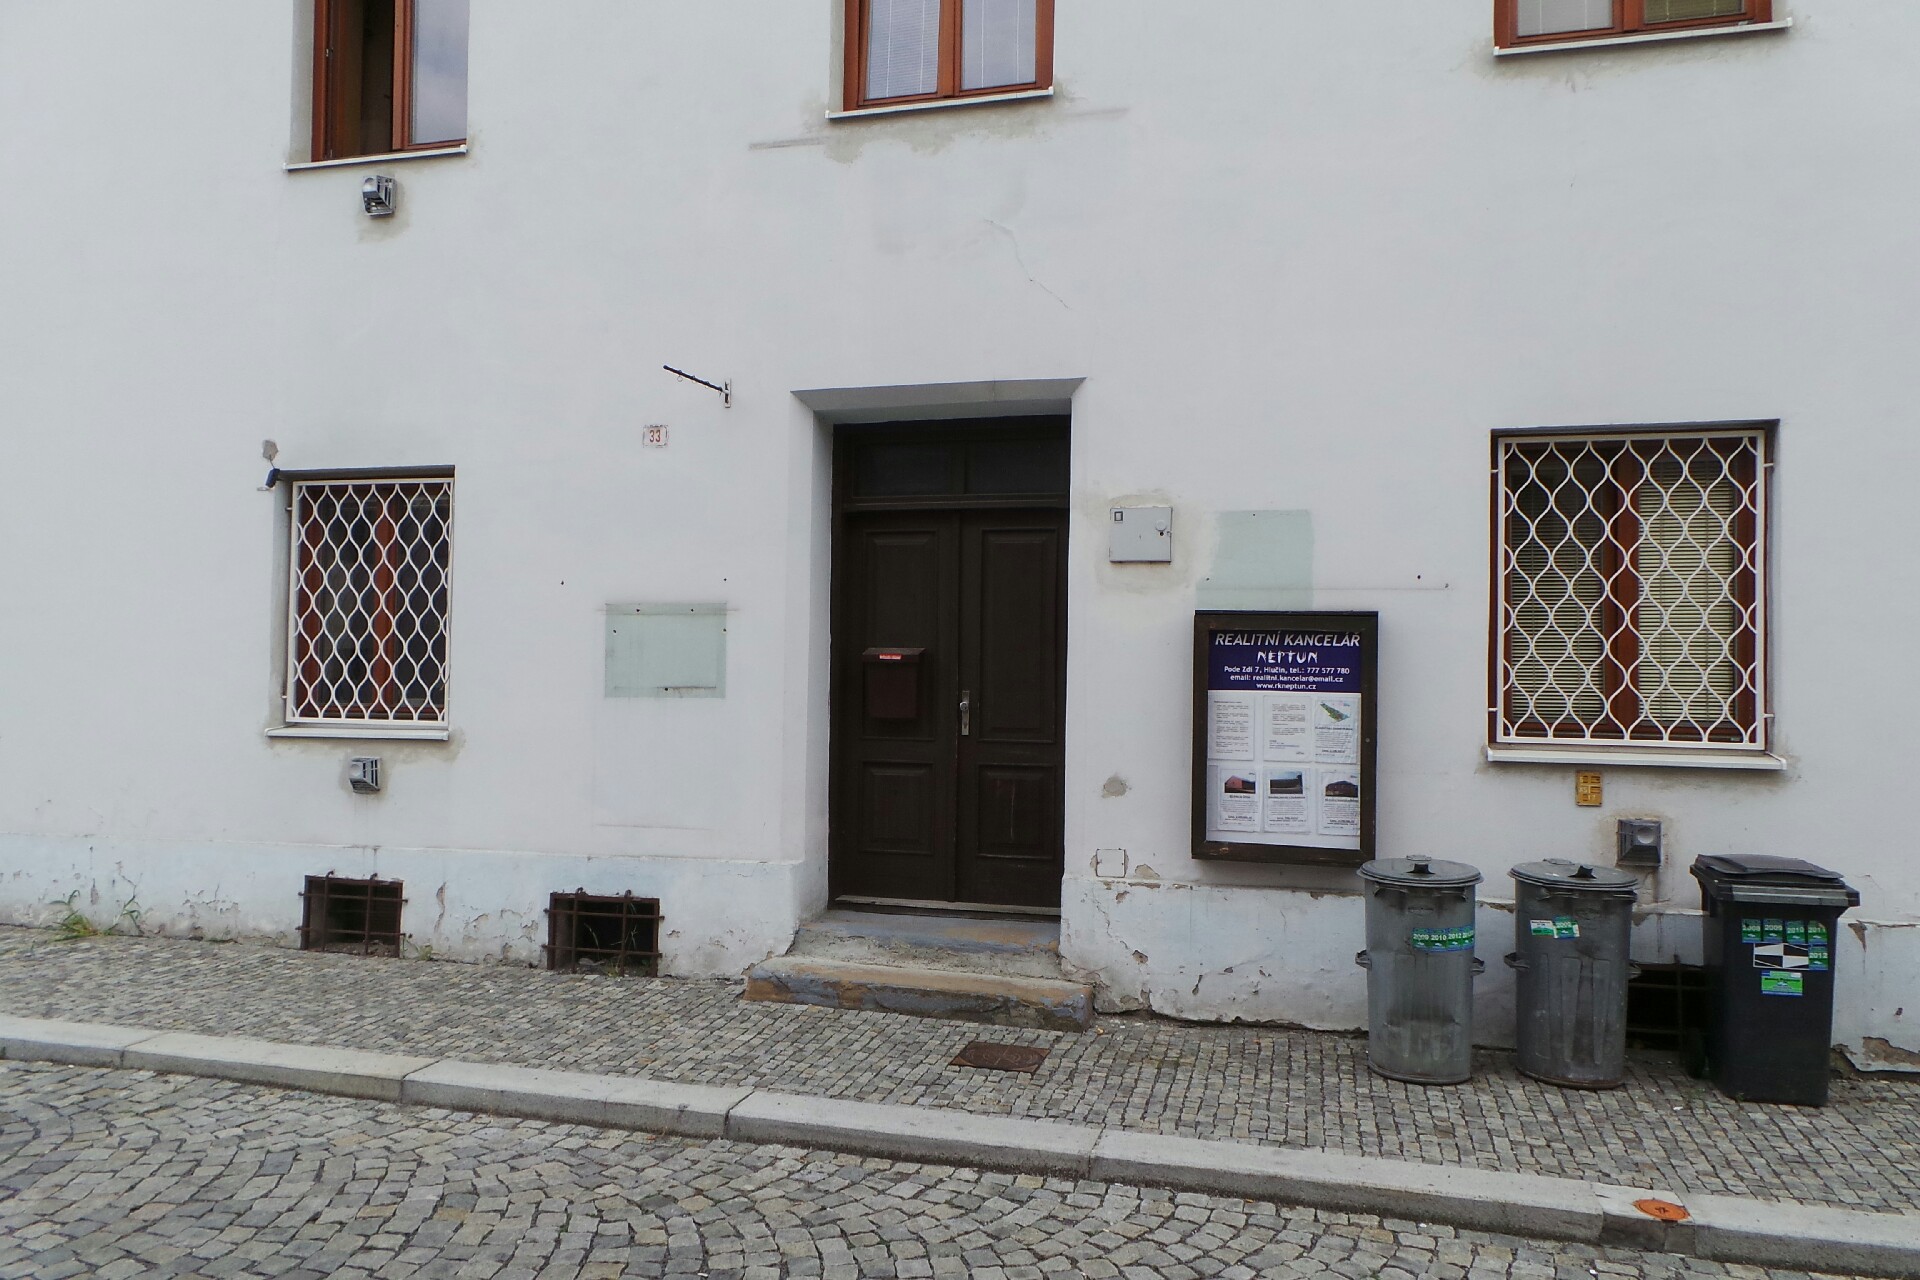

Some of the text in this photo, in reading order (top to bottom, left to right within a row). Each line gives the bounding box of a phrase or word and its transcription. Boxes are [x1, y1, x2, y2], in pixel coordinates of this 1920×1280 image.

[649, 429, 661, 443] 33
[1215, 631, 1360, 647] REALITNÍ KANCELÁŘ
[1257, 650, 1318, 664] NEPTUN
[1337, 667, 1350, 675] 780
[1256, 683, 1317, 691] www.rkneptun.cz
